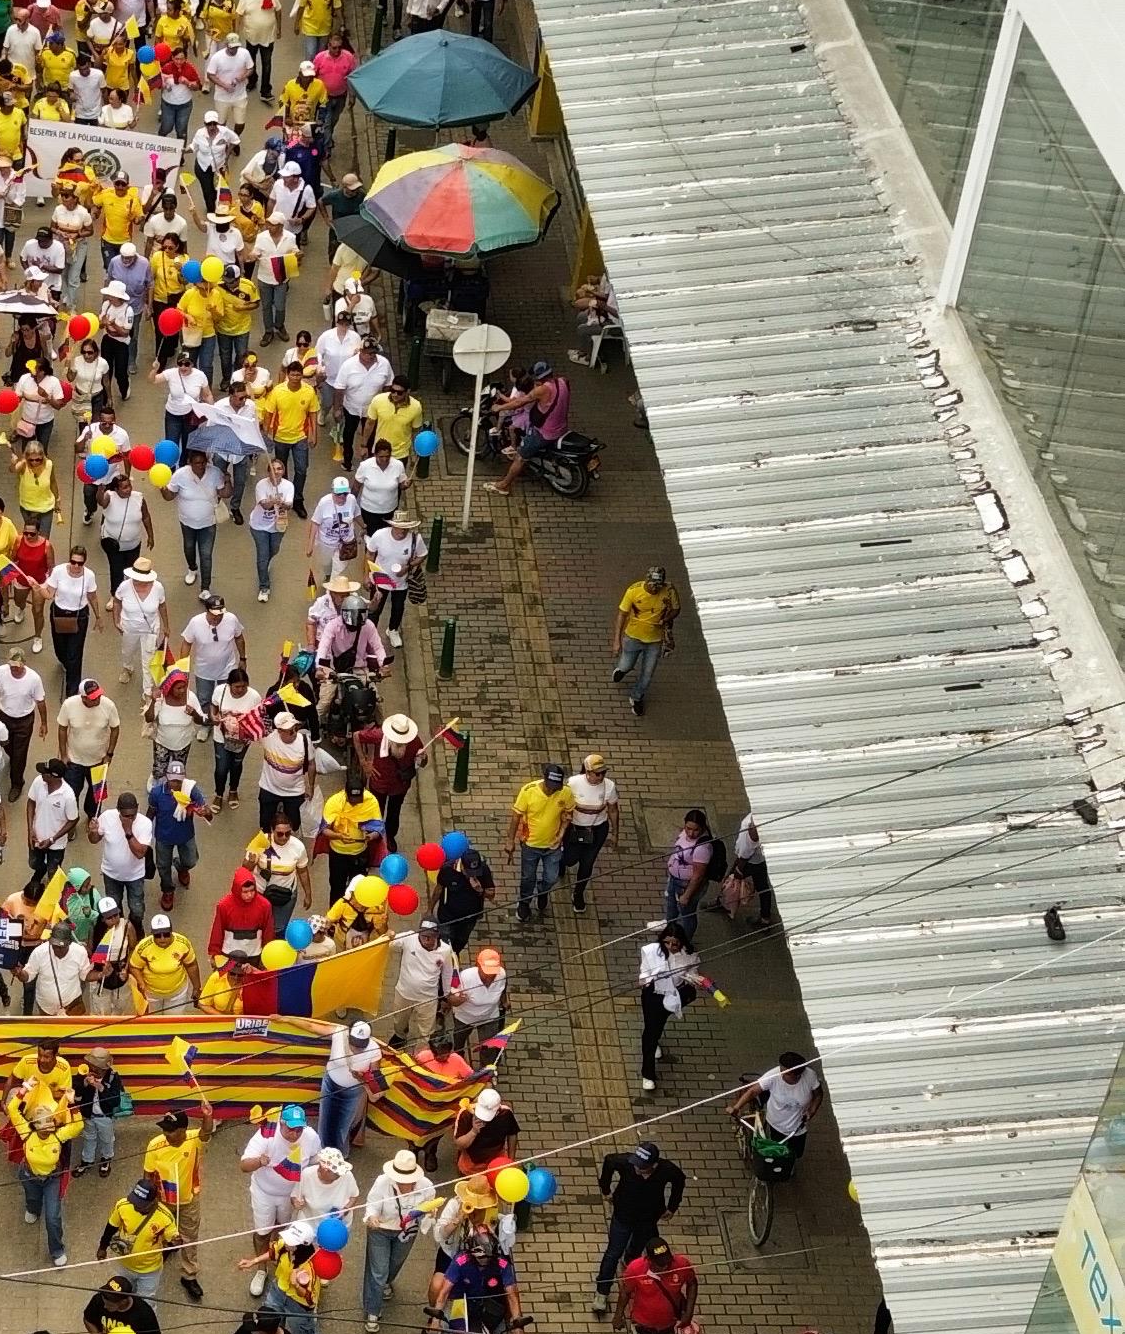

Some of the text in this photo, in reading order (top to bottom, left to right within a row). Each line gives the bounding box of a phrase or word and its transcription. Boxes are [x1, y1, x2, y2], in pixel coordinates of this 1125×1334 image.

[30, 127, 57, 138] RESERVA
[59, 131, 67, 139] DE
[68, 132, 76, 140] LA
[103, 136, 134, 149] NACIONAL
[135, 141, 145, 150] DE
[145, 143, 177, 154] COLOMBIA
[236, 1018, 268, 1028] URIBE
